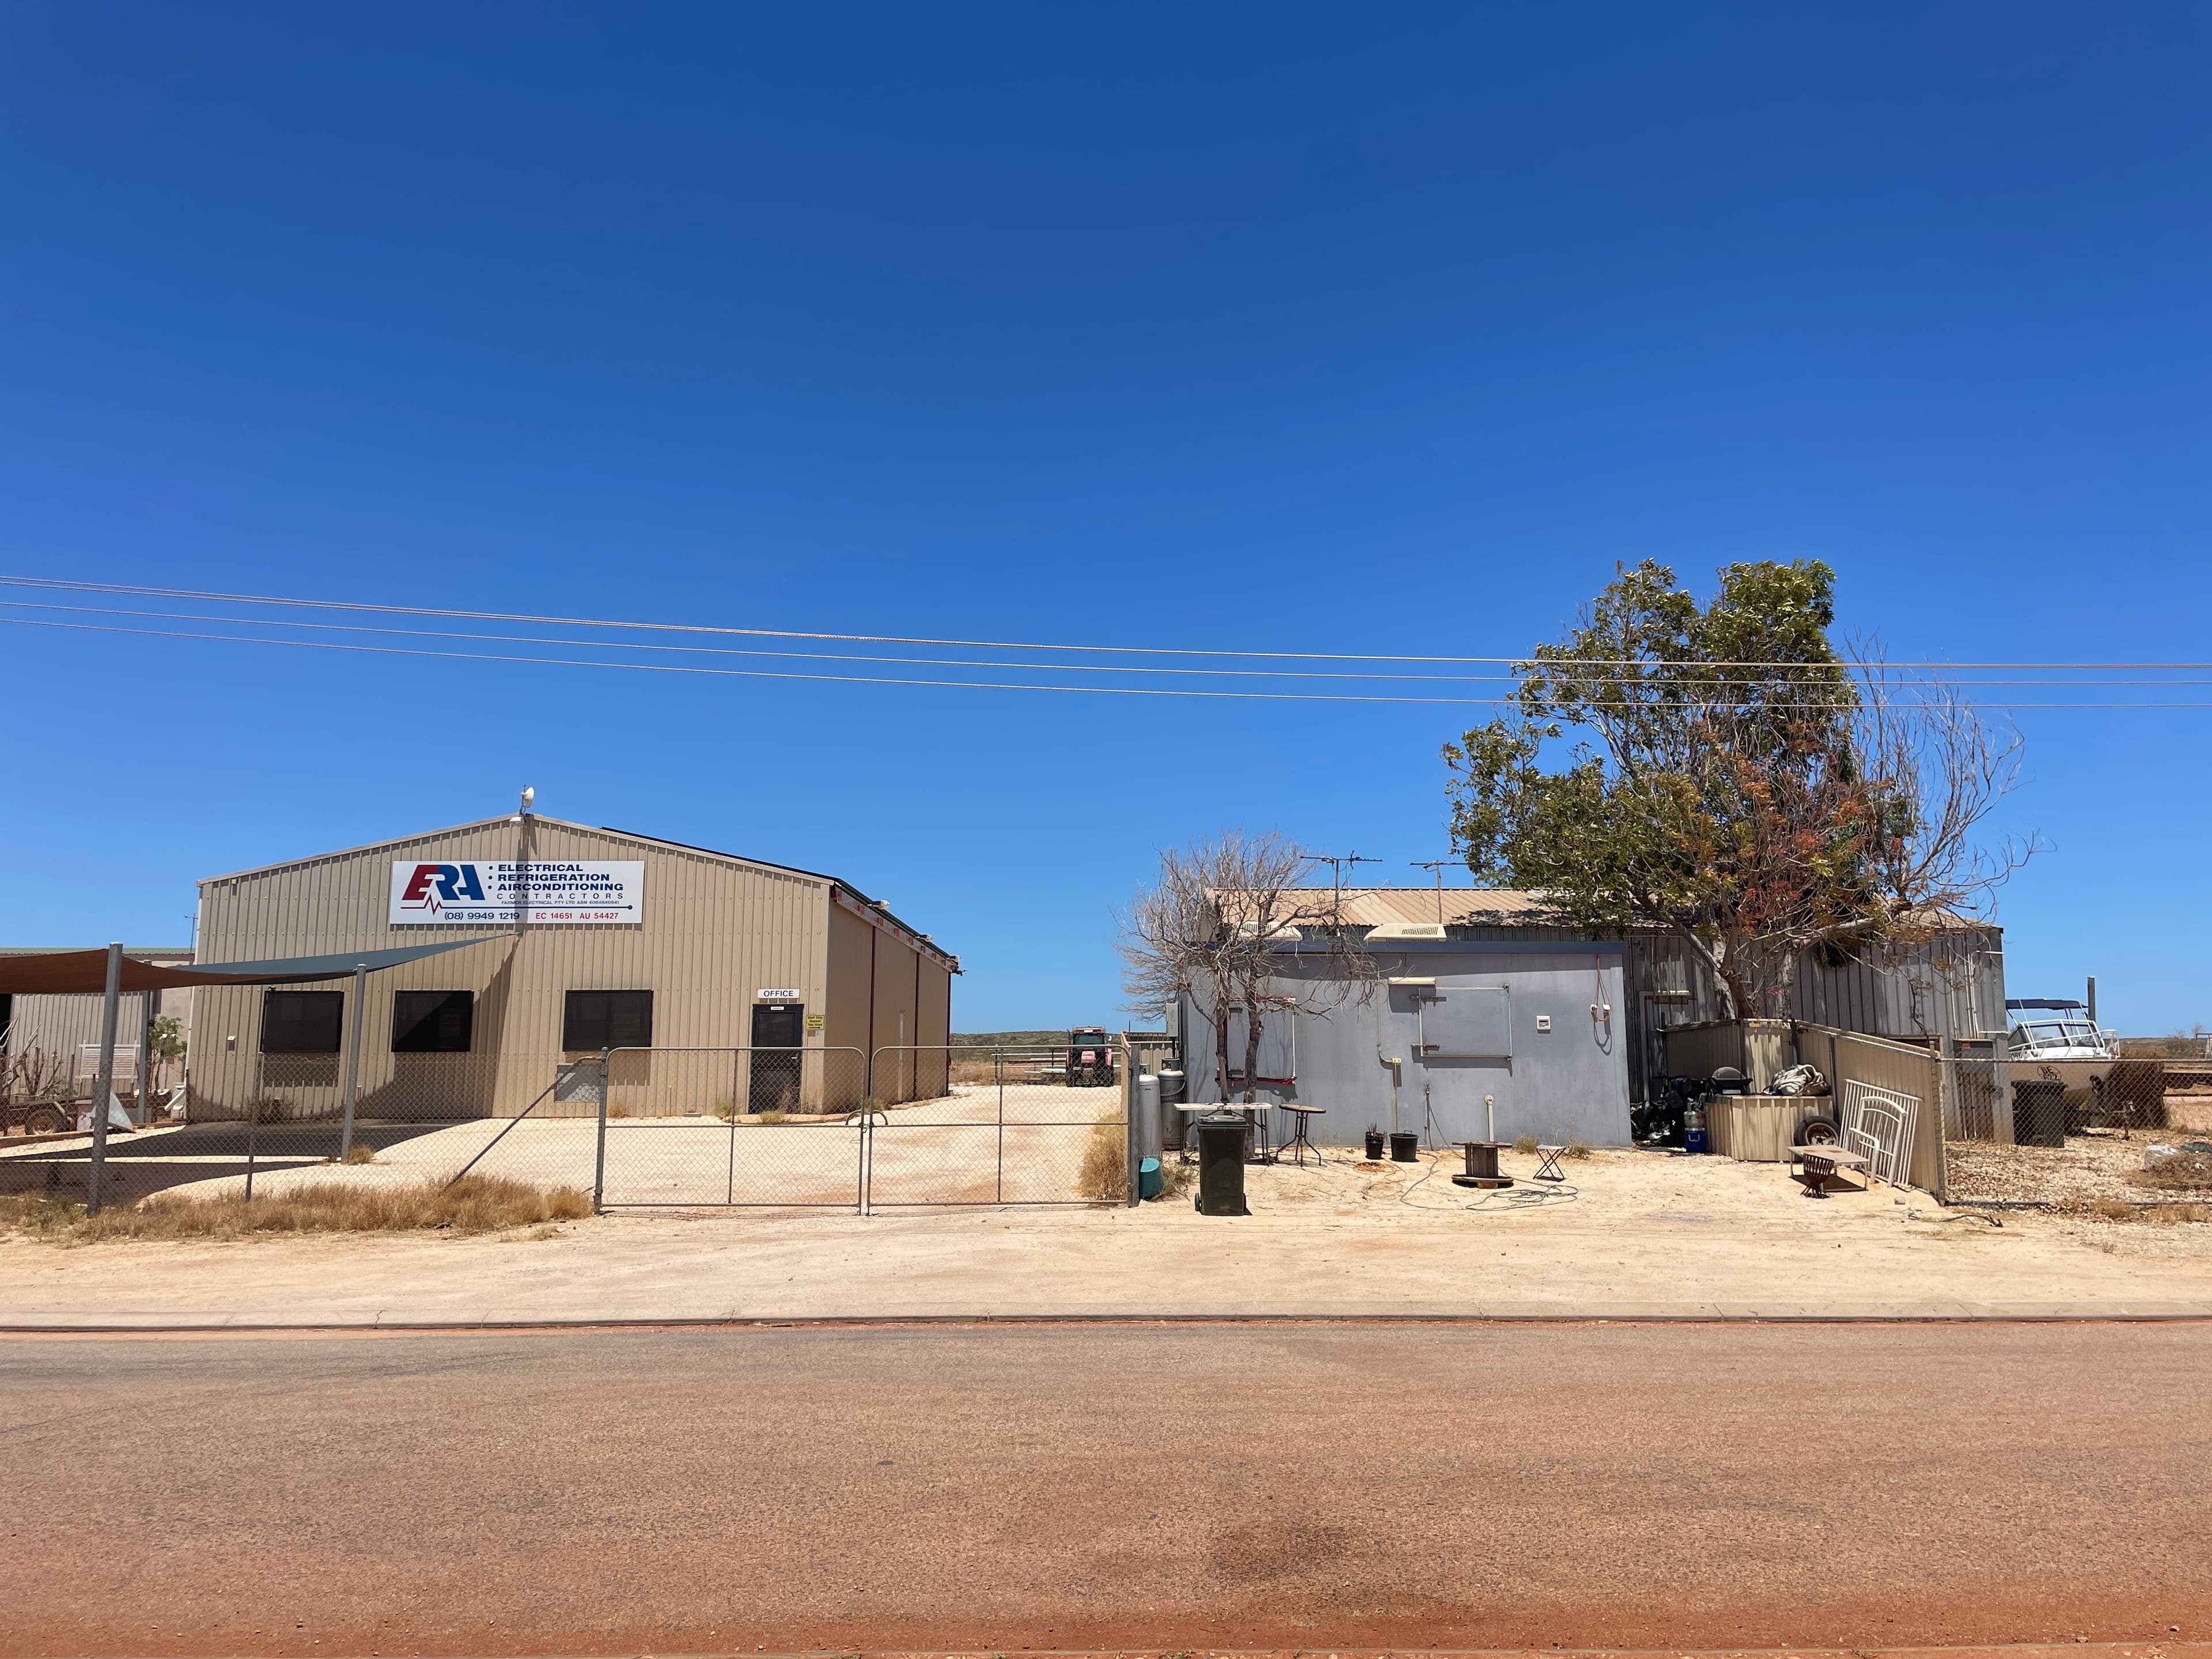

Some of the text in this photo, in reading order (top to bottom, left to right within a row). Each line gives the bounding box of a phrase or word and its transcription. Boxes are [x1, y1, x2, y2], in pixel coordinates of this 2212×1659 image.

[402, 865, 486, 900] ERA
[497, 883, 623, 891] AIRCONDITIONING
[445, 912, 464, 921] (08)
